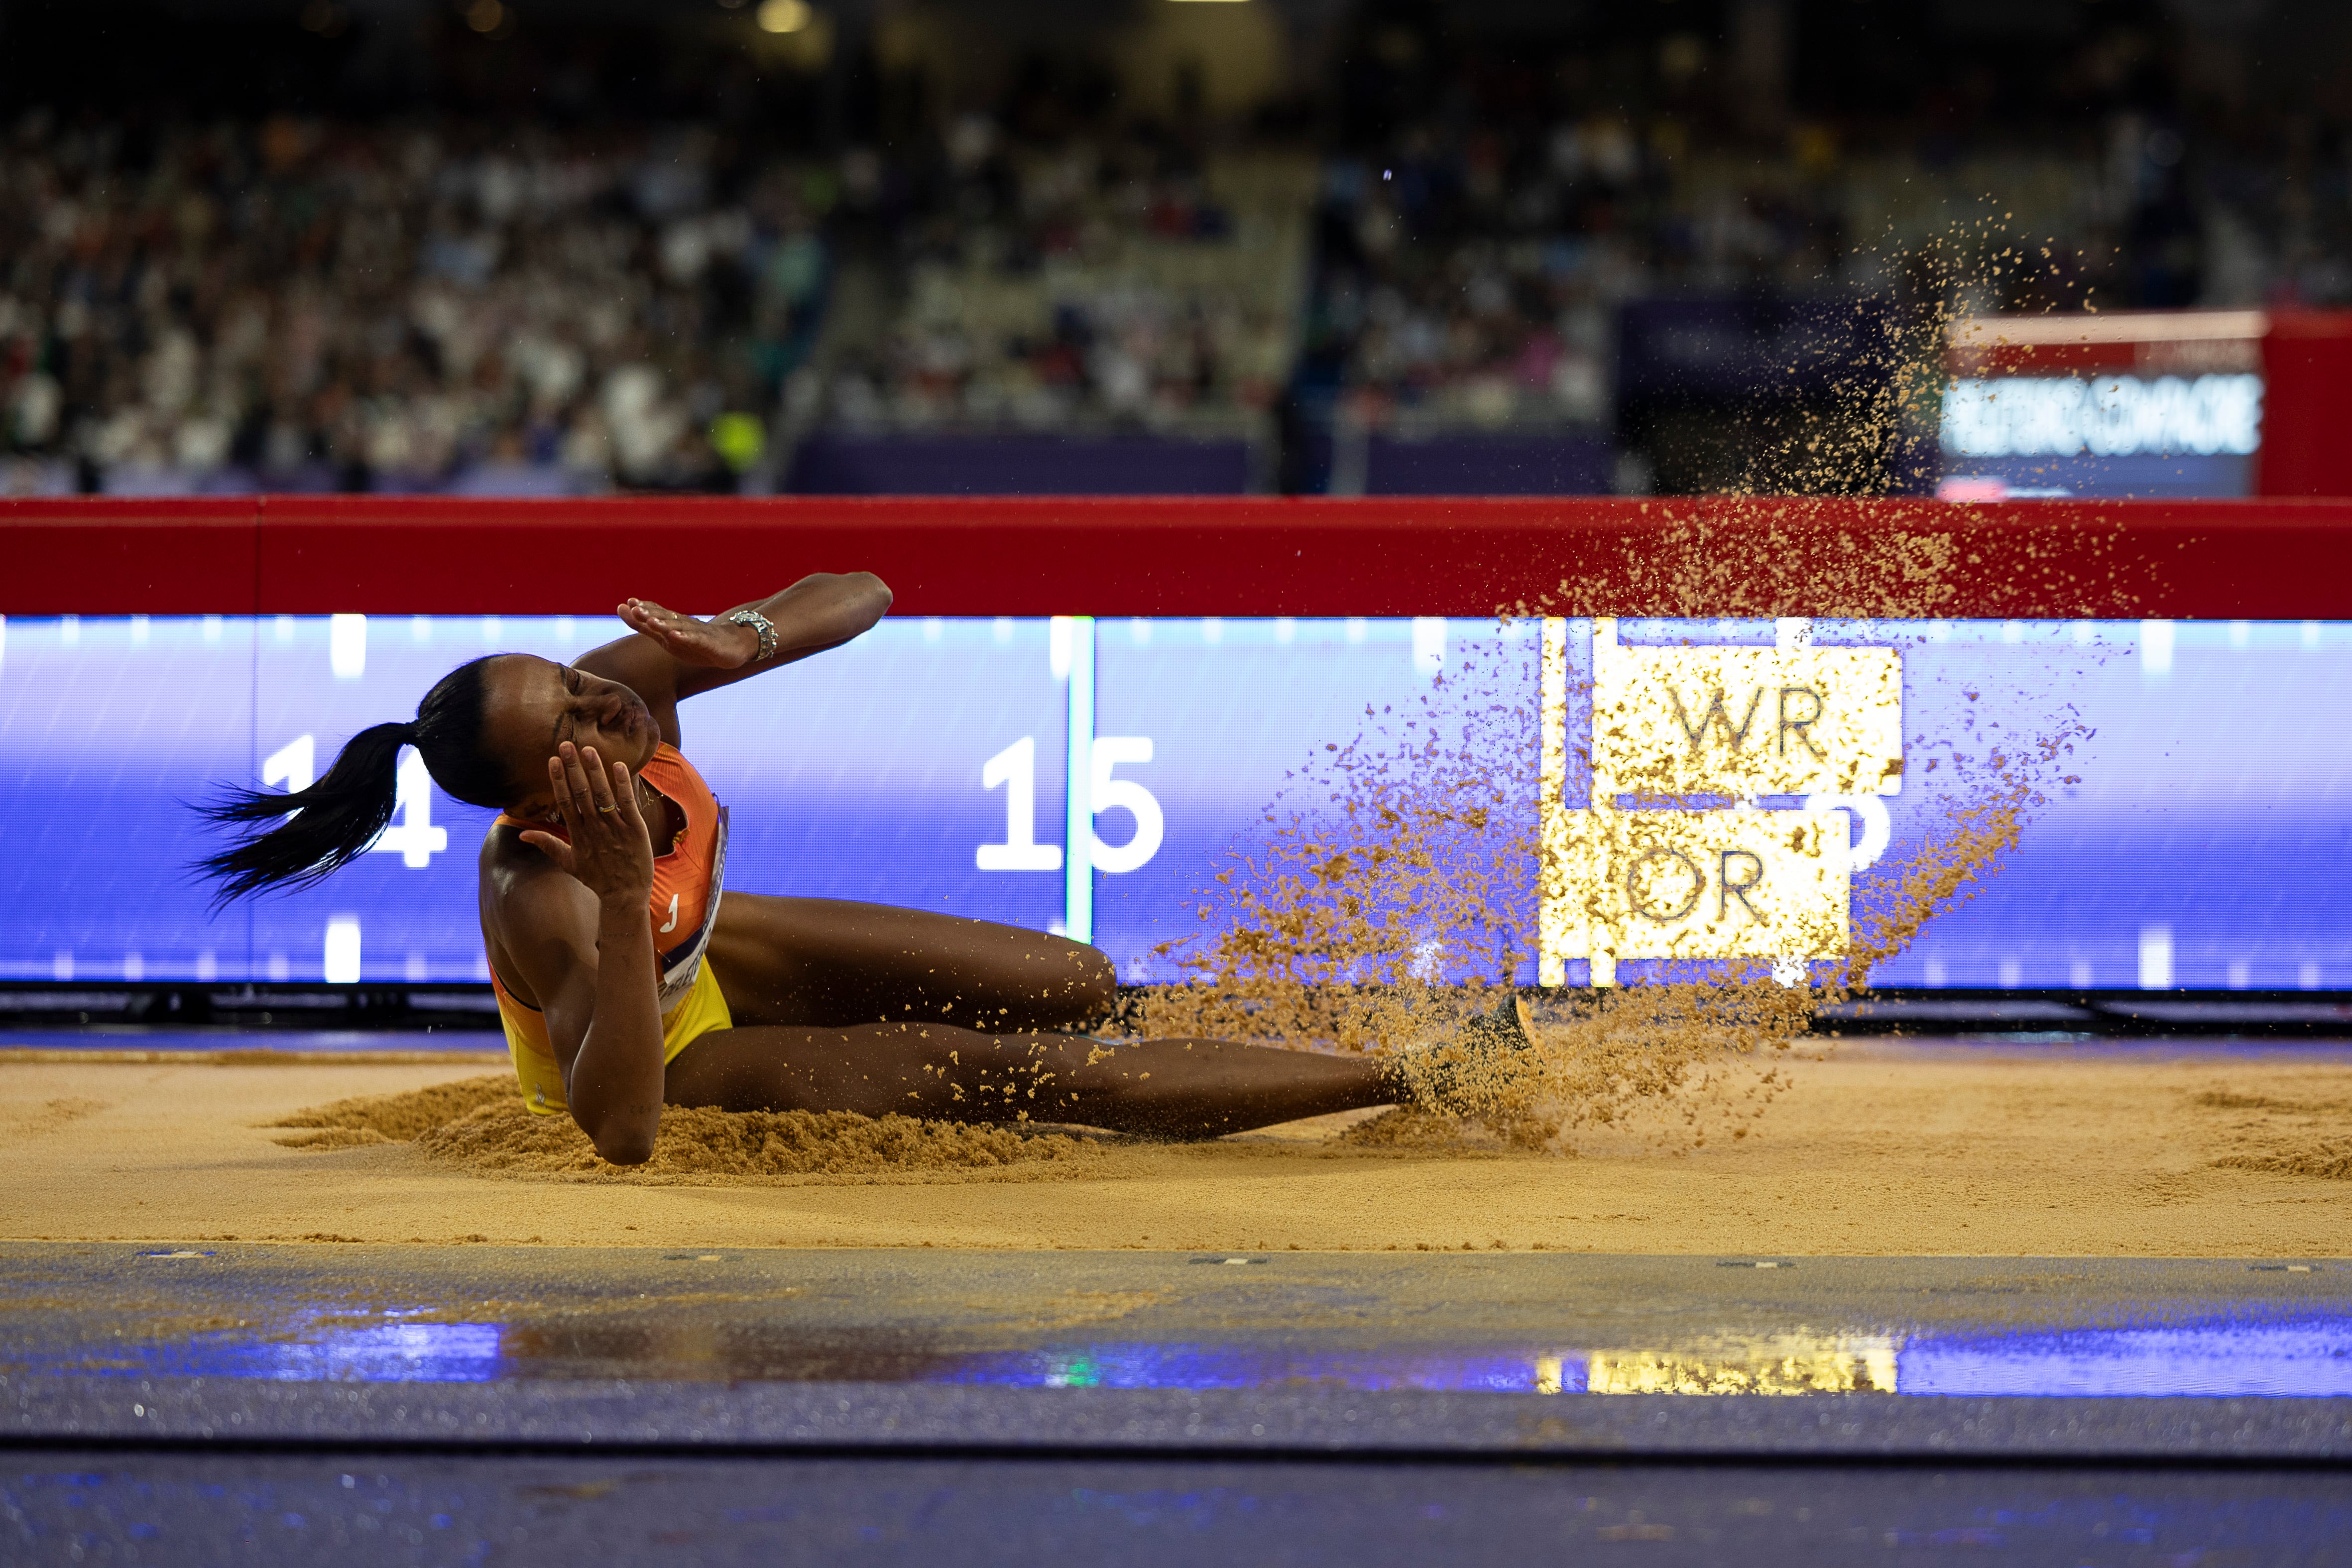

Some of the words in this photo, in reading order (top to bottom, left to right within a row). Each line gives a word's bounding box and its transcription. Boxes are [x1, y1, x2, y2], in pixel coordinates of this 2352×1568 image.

[1667, 686, 1827, 757] WR
[976, 736, 1164, 873] 15
[1626, 848, 1767, 922] OR
